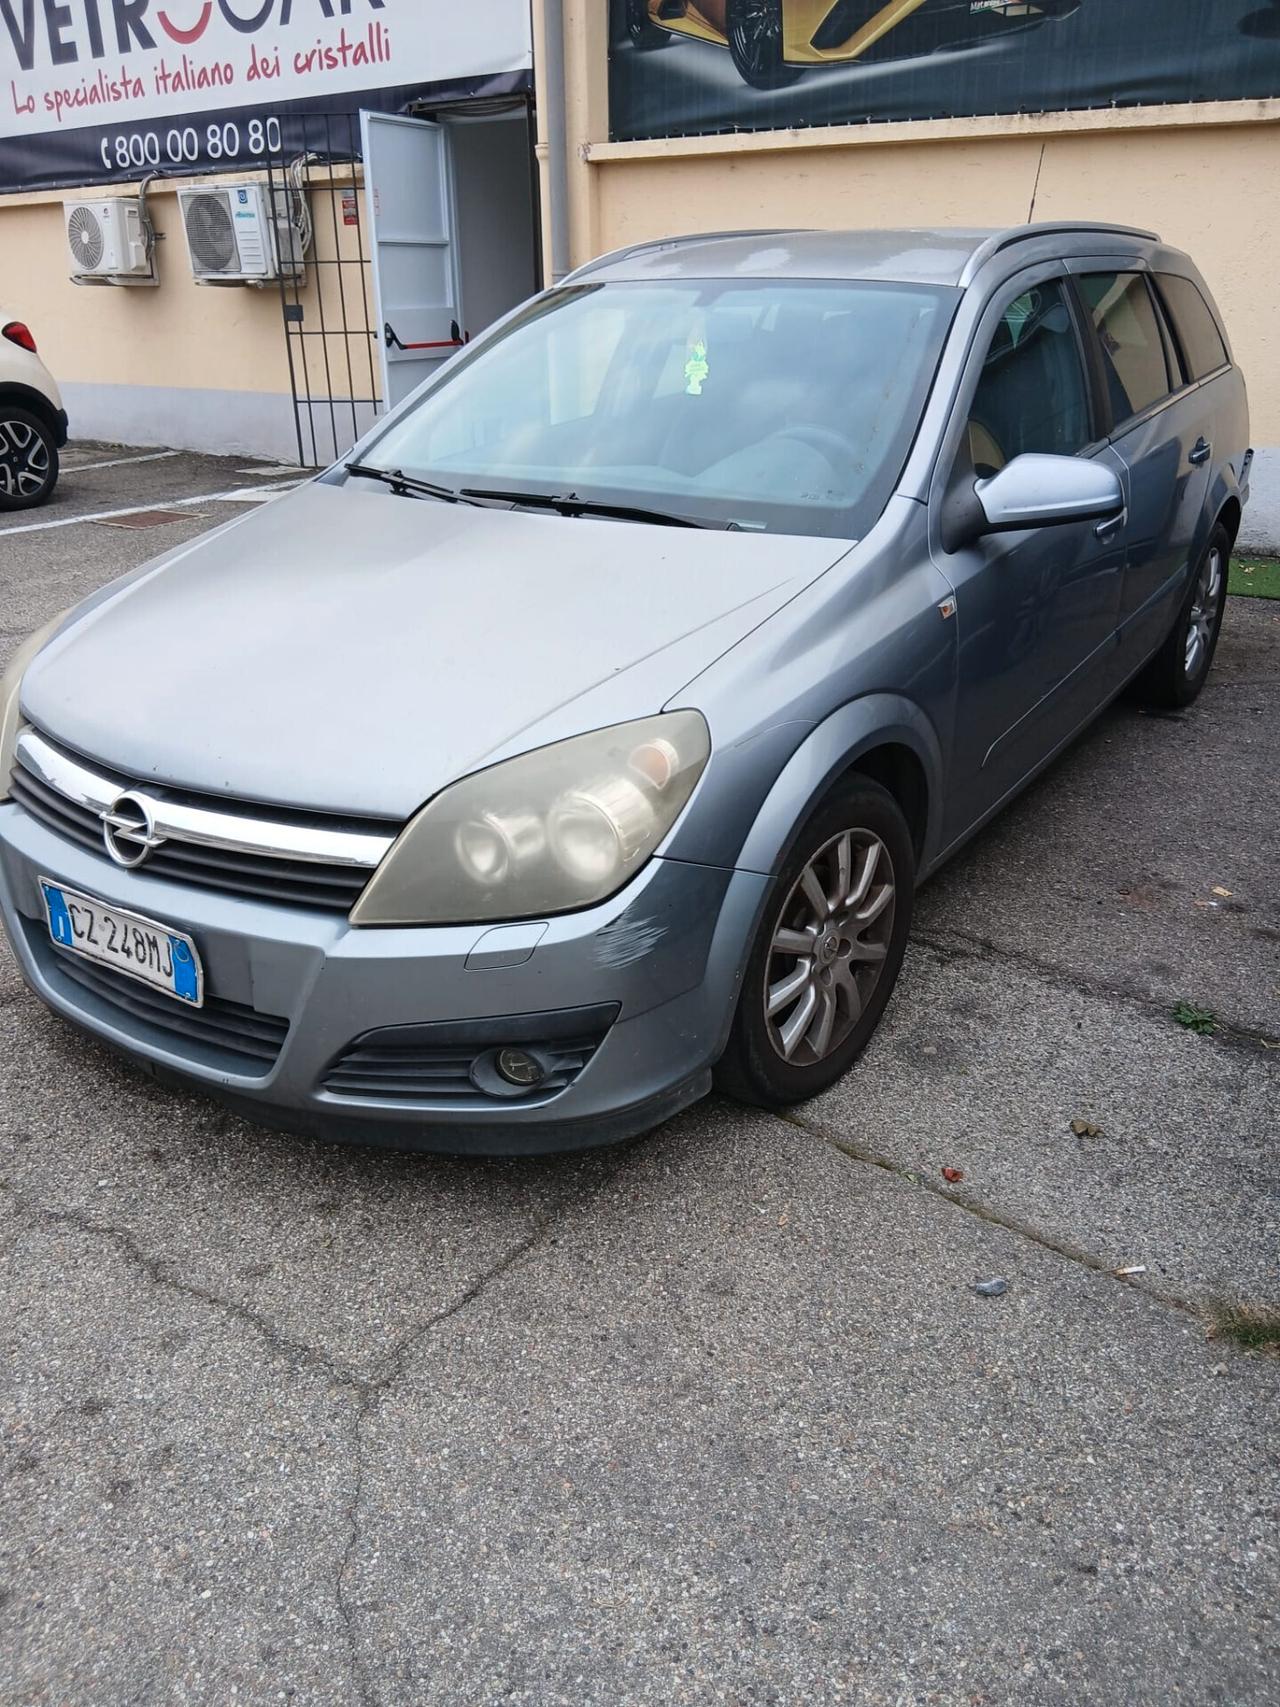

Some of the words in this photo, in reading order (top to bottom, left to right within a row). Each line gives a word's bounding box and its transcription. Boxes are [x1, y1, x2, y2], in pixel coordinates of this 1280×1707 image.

[0, 0, 386, 71] VETR
[11, 80, 35, 115] Lo
[44, 65, 146, 122] specialista
[153, 54, 234, 95] italiano
[246, 43, 281, 82] dei
[293, 21, 391, 74] cristalli
[115, 132, 160, 168] 800
[166, 127, 199, 163] 00
[206, 122, 240, 159] 80
[248, 117, 282, 155] 80
